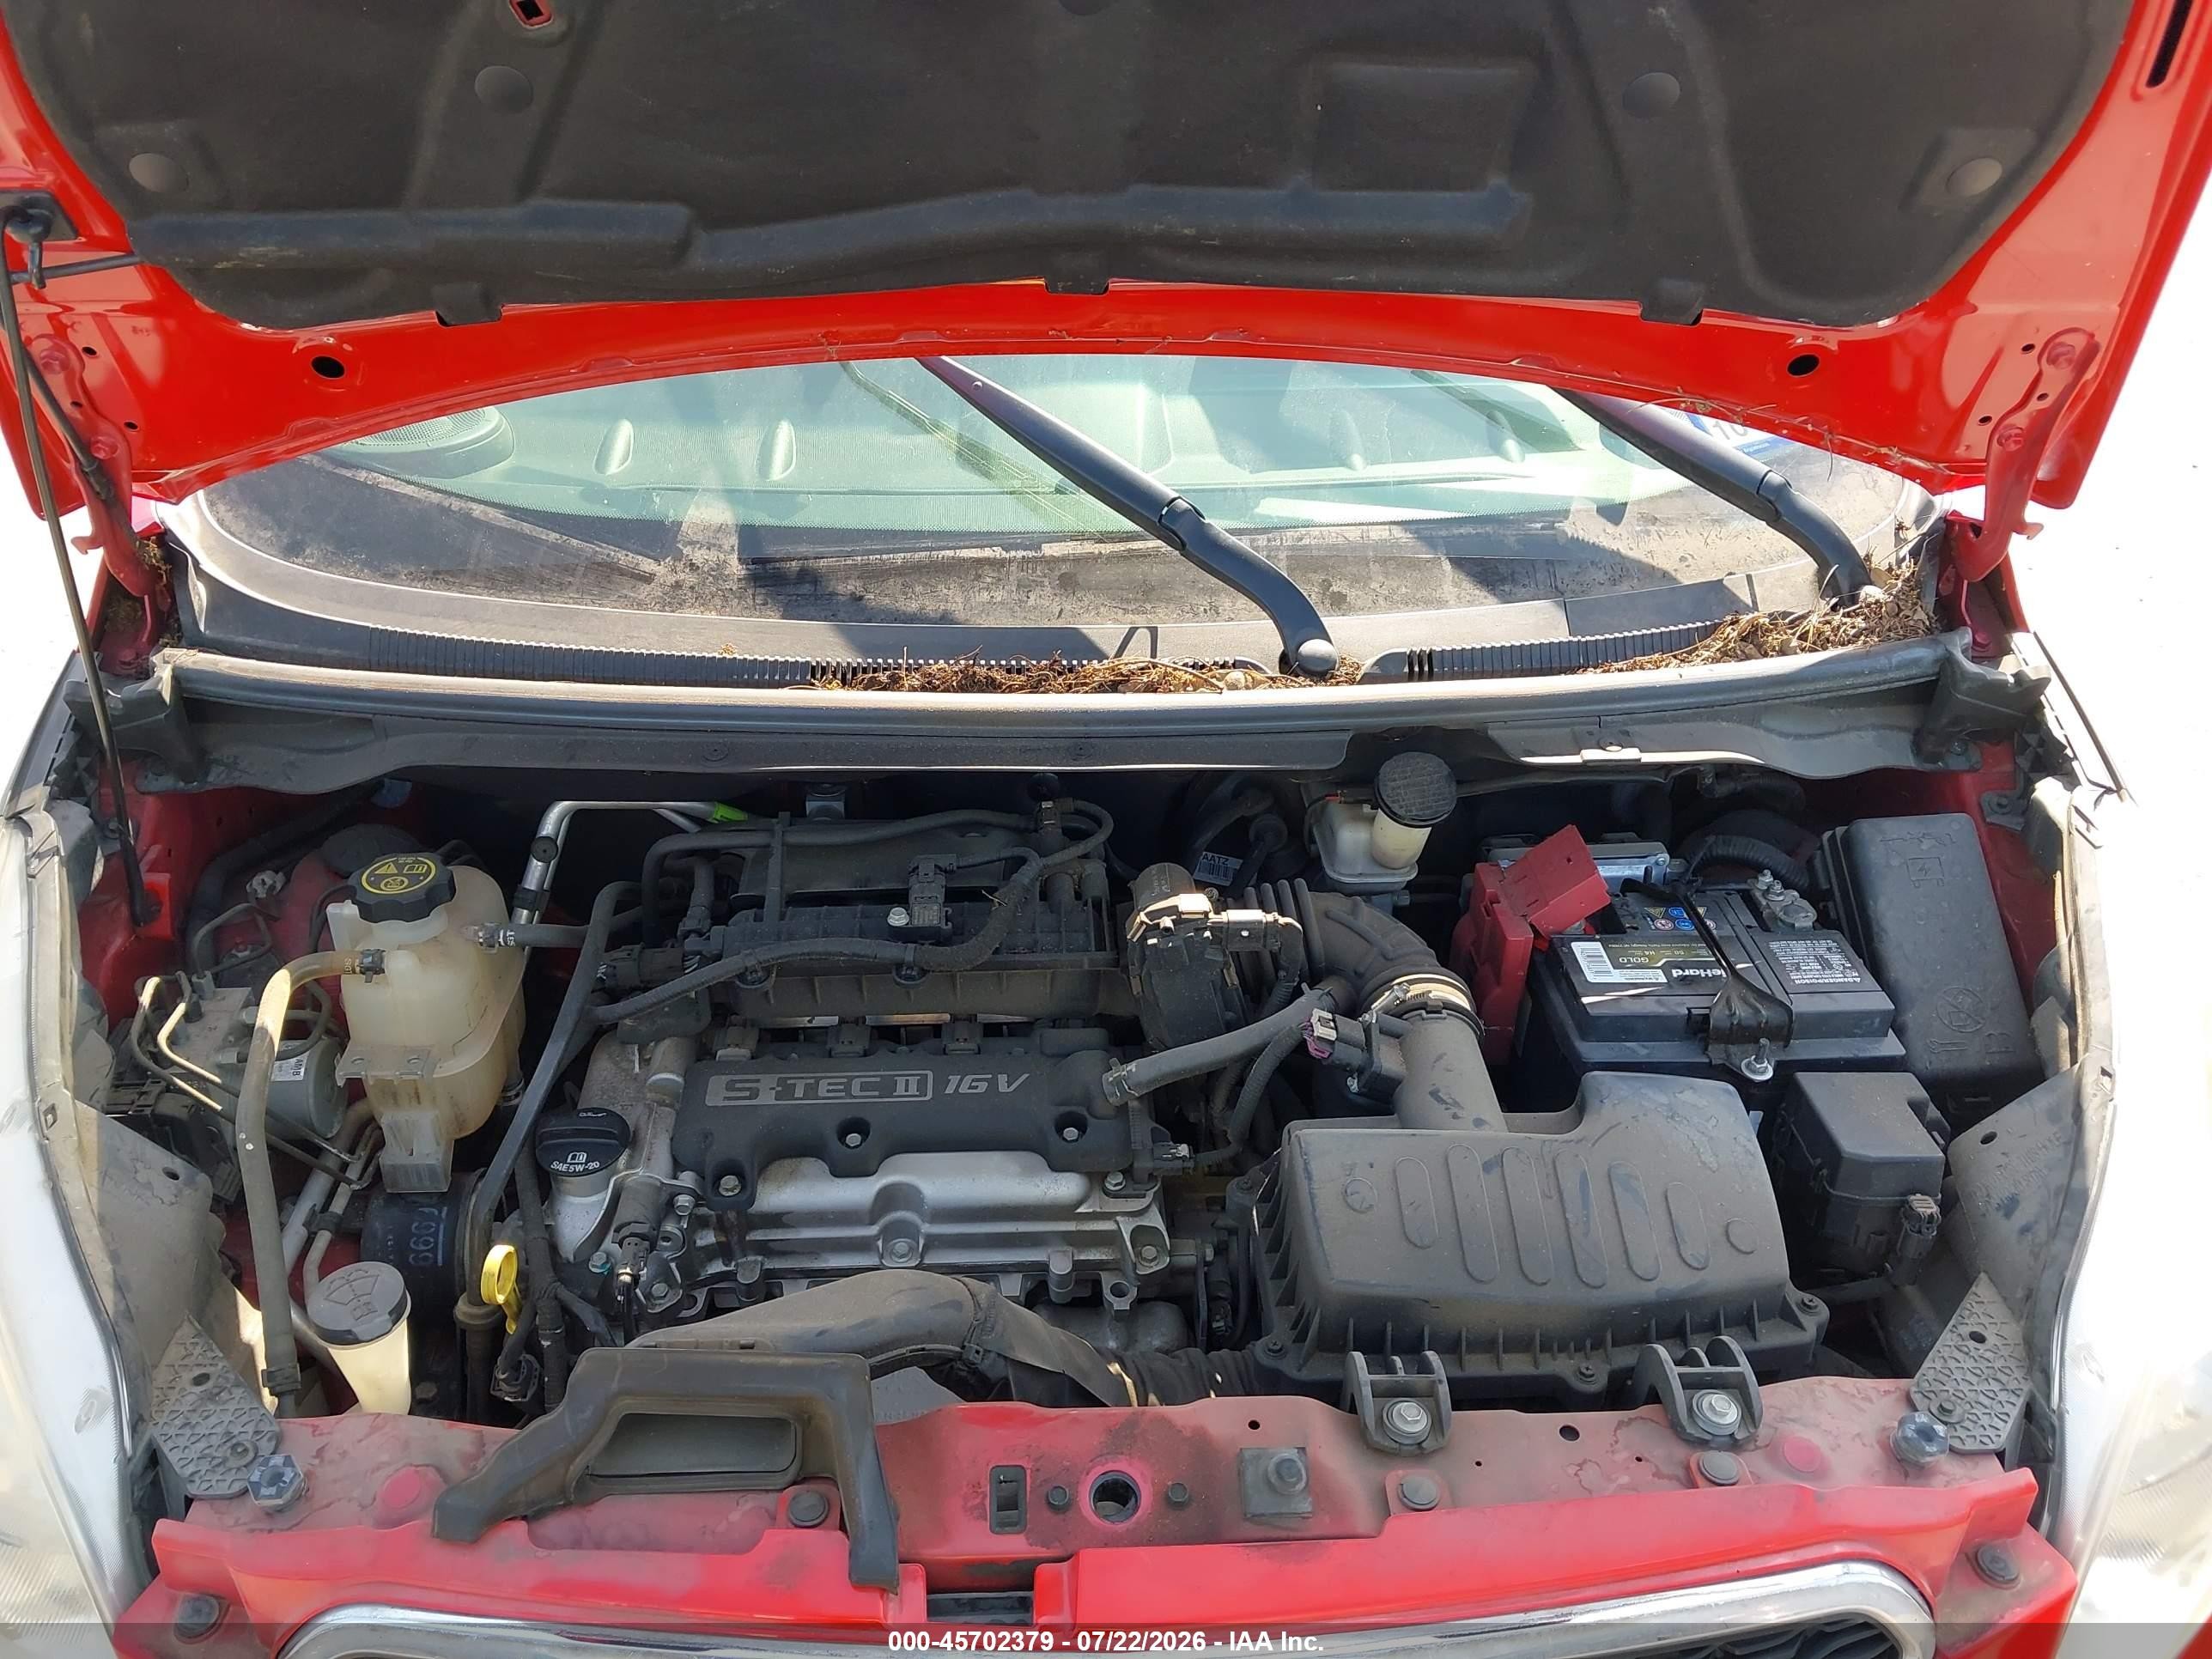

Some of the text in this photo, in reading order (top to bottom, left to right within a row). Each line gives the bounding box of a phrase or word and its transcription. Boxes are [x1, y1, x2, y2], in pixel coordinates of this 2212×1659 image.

[1201, 853, 1230, 866] AATZ
[1671, 968, 1728, 978] ieHard
[292, 1059, 304, 1077] AMB
[944, 1073, 1030, 1094] 16V
